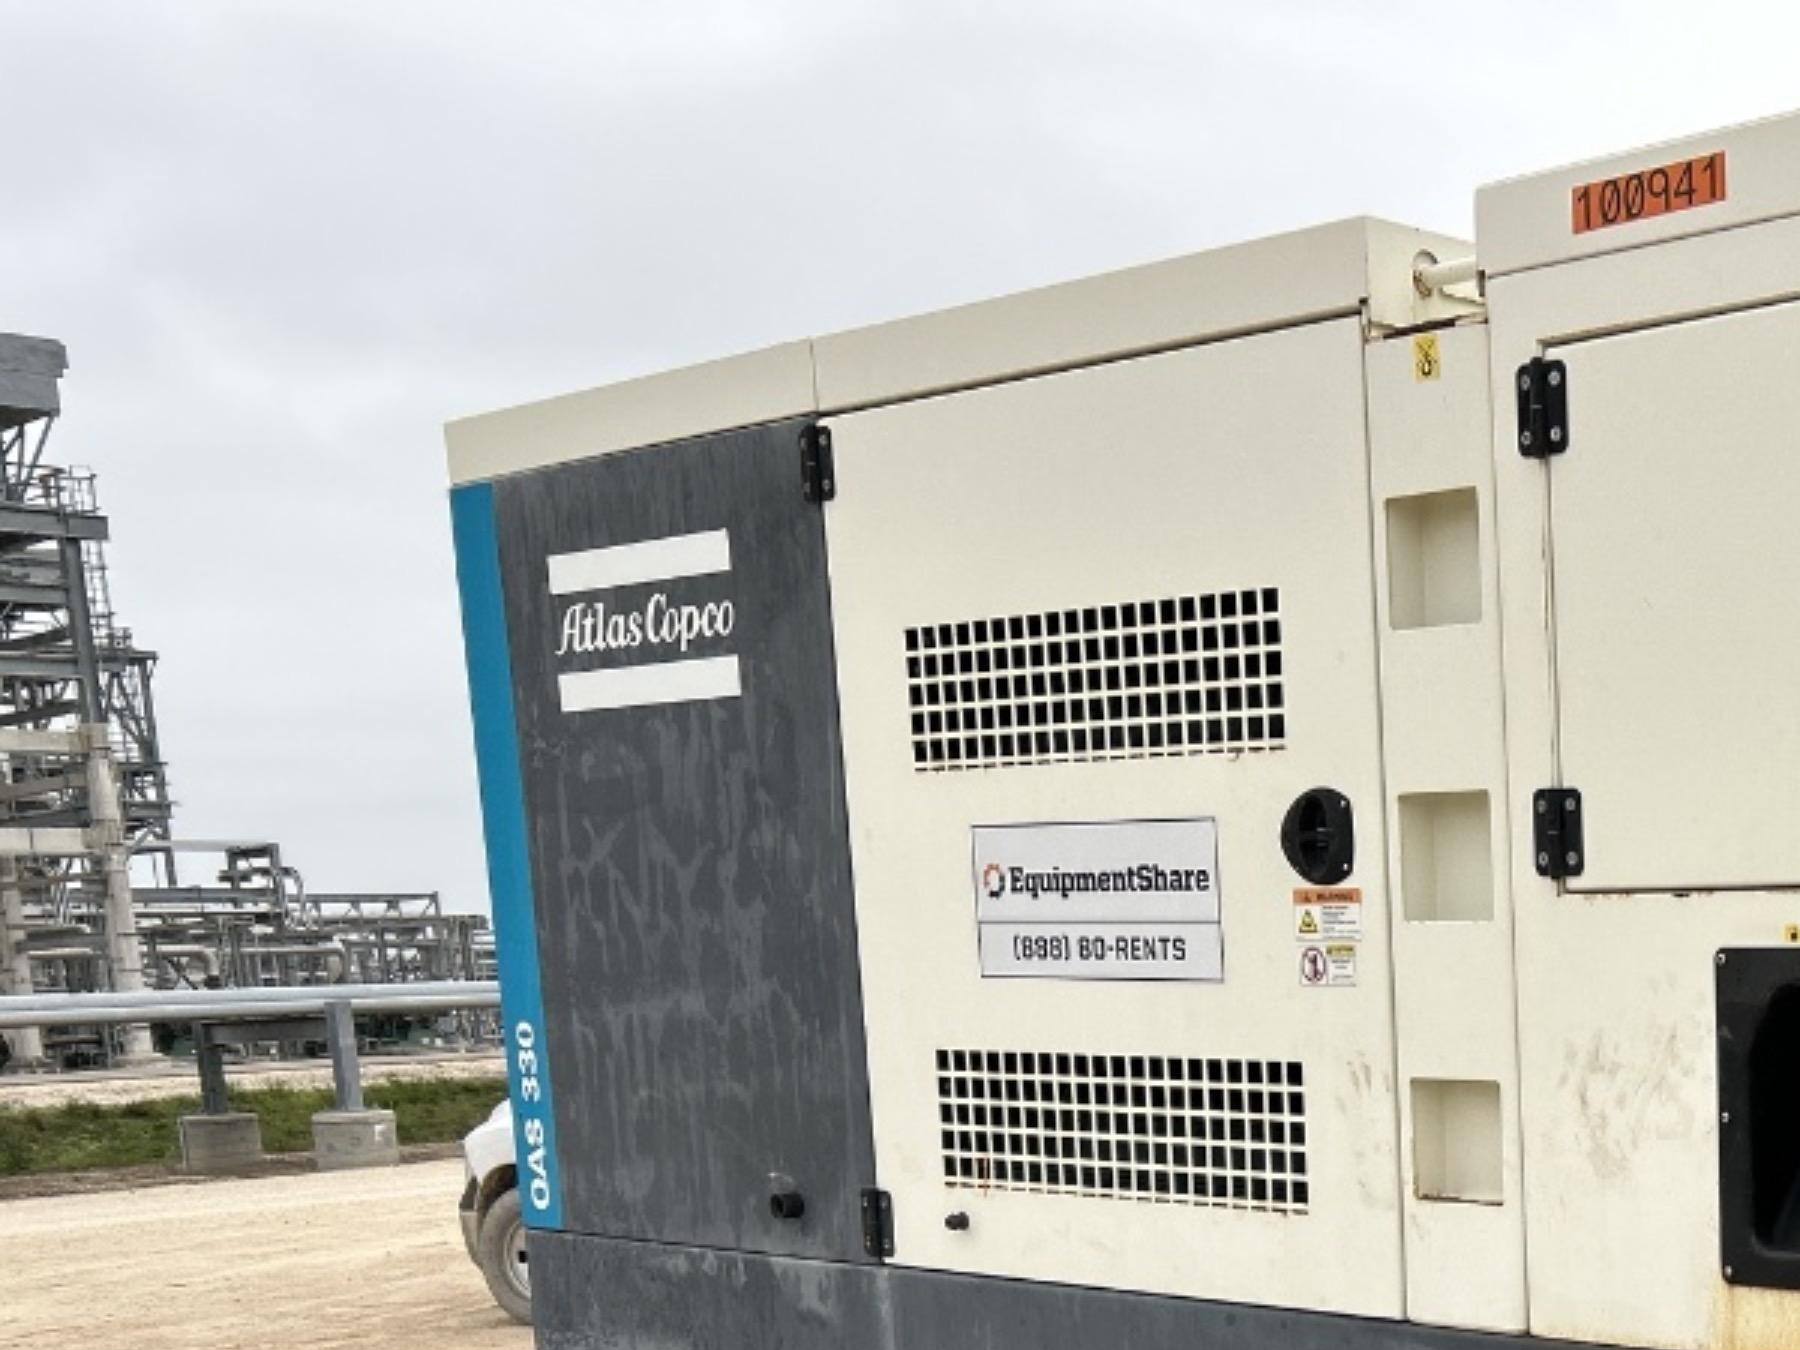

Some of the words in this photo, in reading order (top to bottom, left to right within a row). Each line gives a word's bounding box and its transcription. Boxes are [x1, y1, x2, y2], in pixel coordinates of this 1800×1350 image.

[1577, 154, 1718, 230] 100941
[1009, 863, 1210, 900] EquipmentShare
[1012, 935, 1072, 962] (888)
[1078, 935, 1188, 962] 80-RENTS
[515, 1021, 541, 1103] 330
